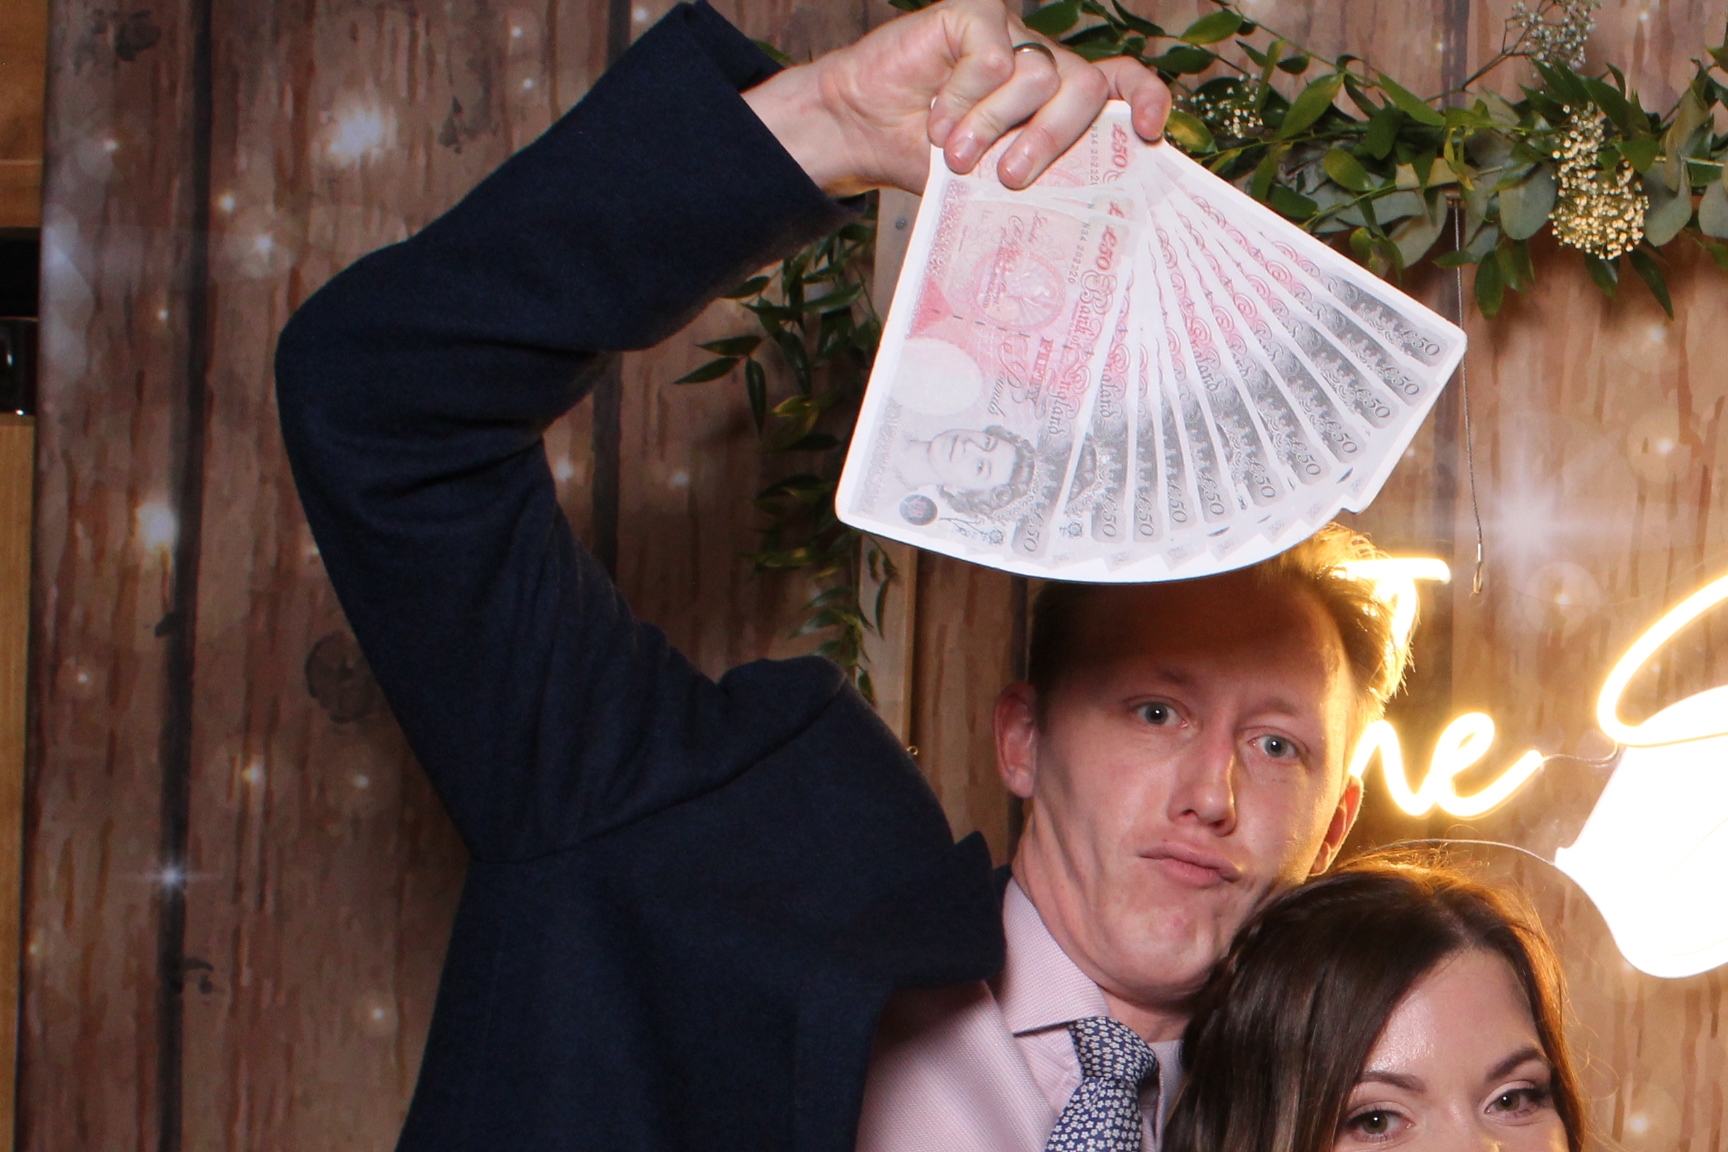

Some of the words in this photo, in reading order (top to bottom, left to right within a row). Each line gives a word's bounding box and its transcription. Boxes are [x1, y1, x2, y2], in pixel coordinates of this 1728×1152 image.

[1112, 122, 1129, 168] £50
[1067, 245, 1085, 284] 202220
[1096, 224, 1118, 271] £50
[1075, 269, 1118, 341] Bank
[1400, 327, 1441, 357] £50
[987, 335, 1030, 418] Pounds
[1026, 336, 1054, 406] FIFTY
[1382, 366, 1420, 396] £50
[1047, 354, 1092, 436] England
[1354, 387, 1391, 419] £50
[1289, 440, 1322, 476] £50
[1325, 420, 1358, 454] £50
[1200, 473, 1225, 516] £50
[1250, 460, 1277, 499] £50
[1102, 494, 1117, 538] £50
[1137, 493, 1155, 537] £50
[1166, 482, 1188, 524] £50
[1023, 510, 1045, 552] £50
